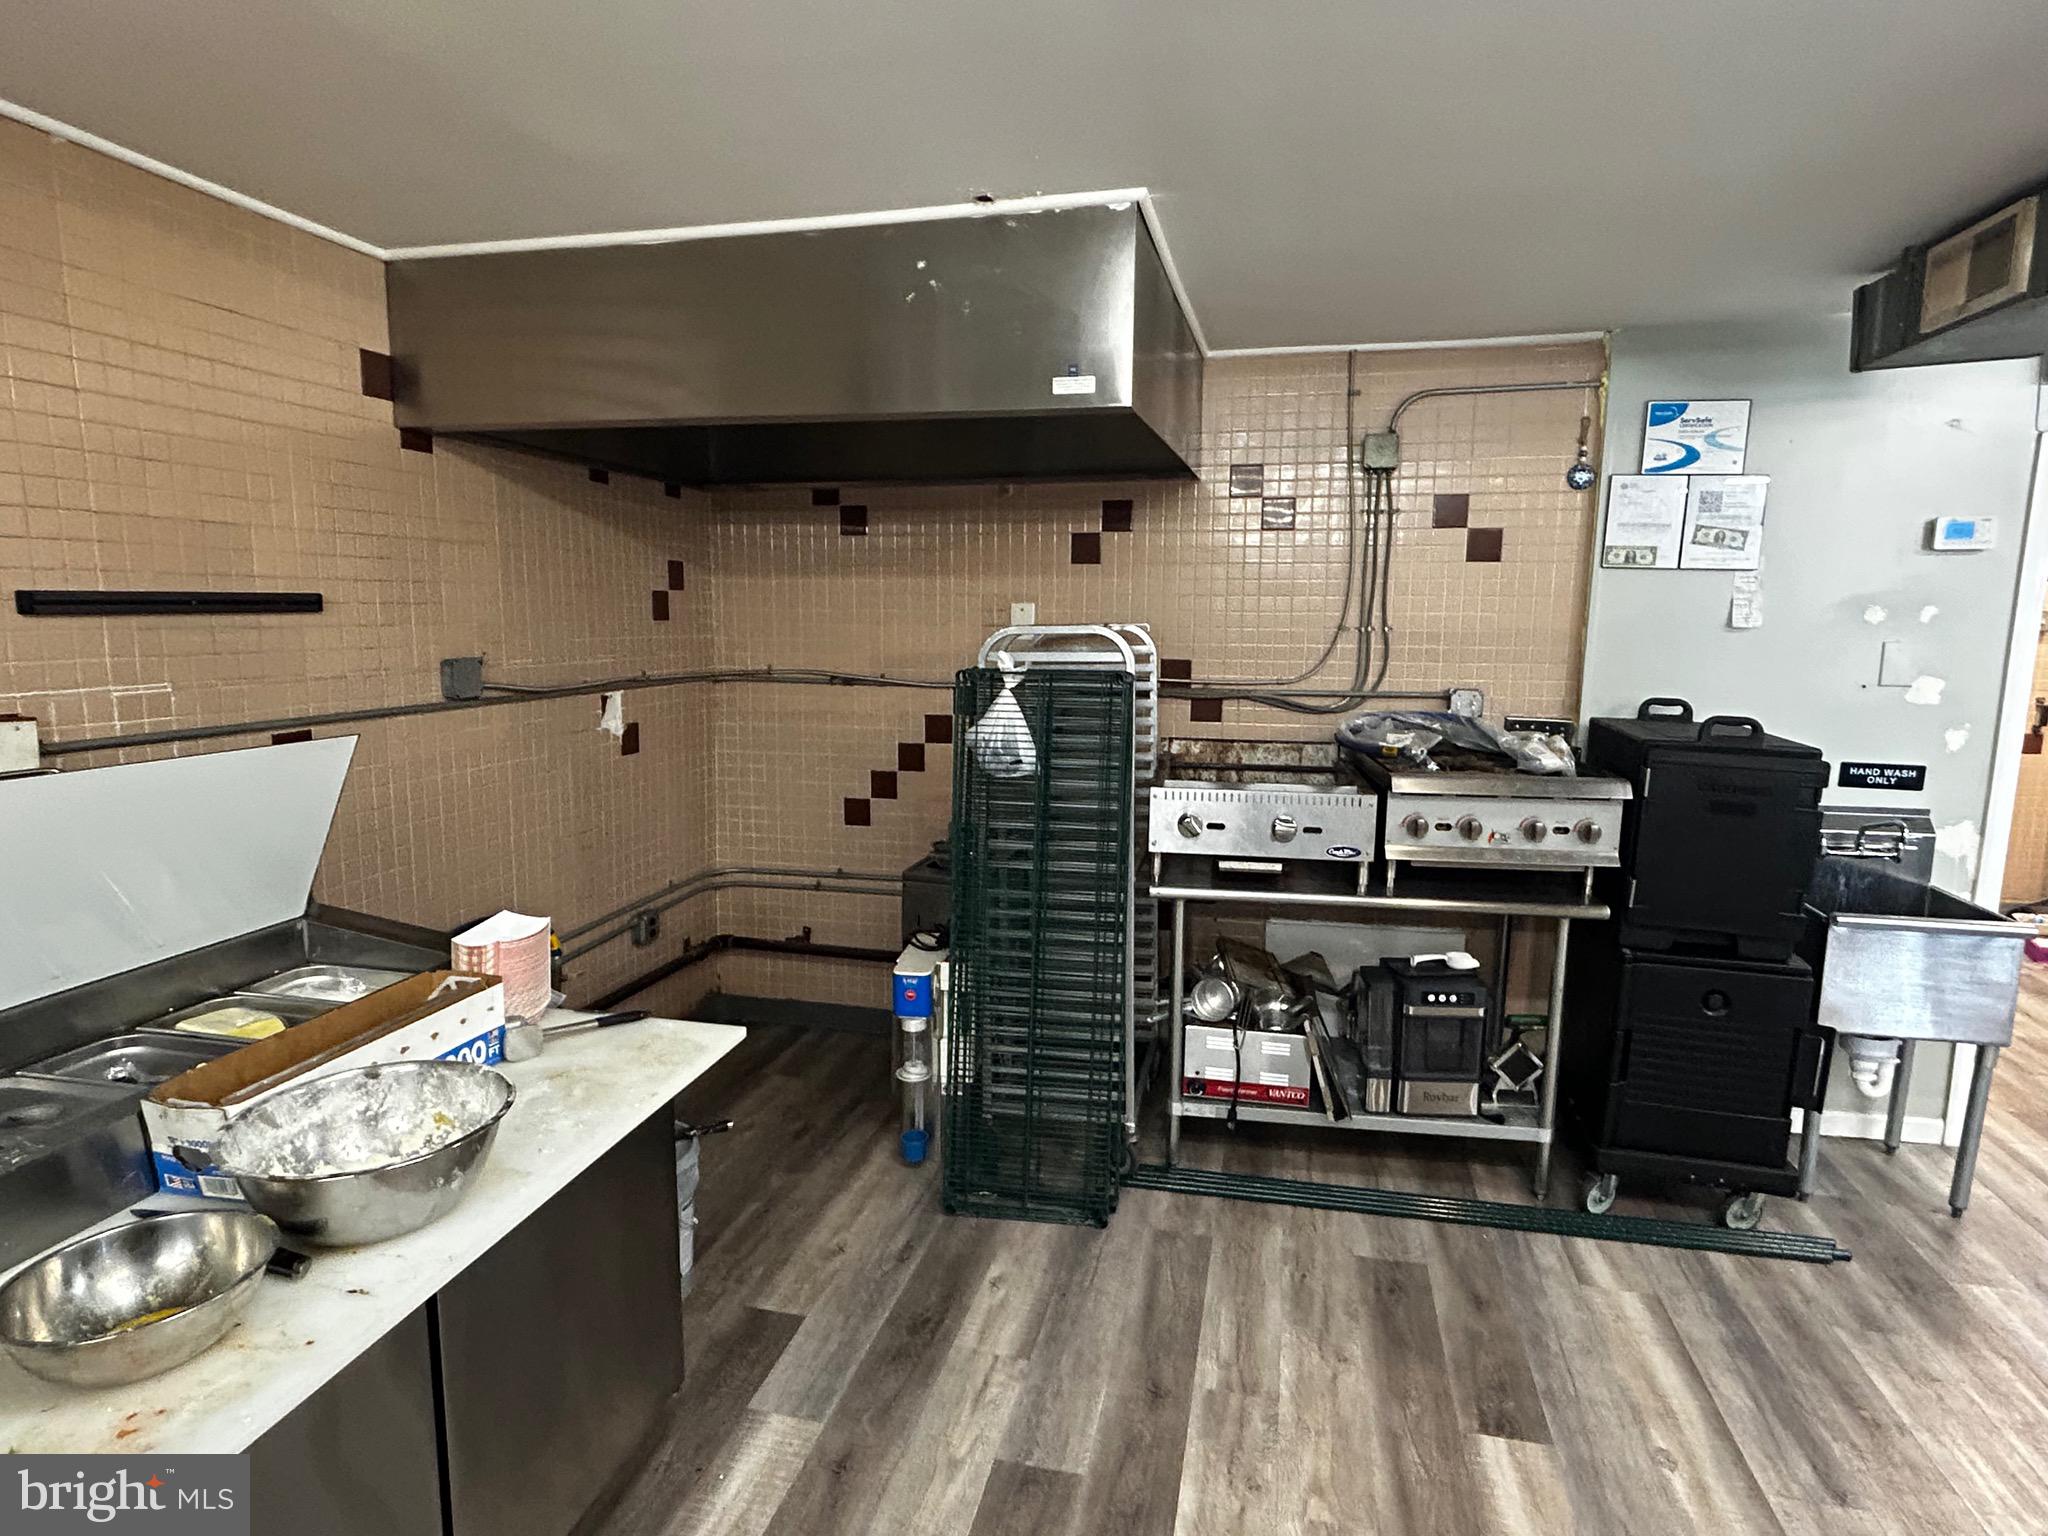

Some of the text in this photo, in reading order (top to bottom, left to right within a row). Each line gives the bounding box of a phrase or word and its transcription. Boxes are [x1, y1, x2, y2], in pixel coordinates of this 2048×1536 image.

[1849, 766, 1917, 779] HAND WASH
[1866, 776, 1898, 786] ONLY
[488, 1044, 501, 1059] FT
